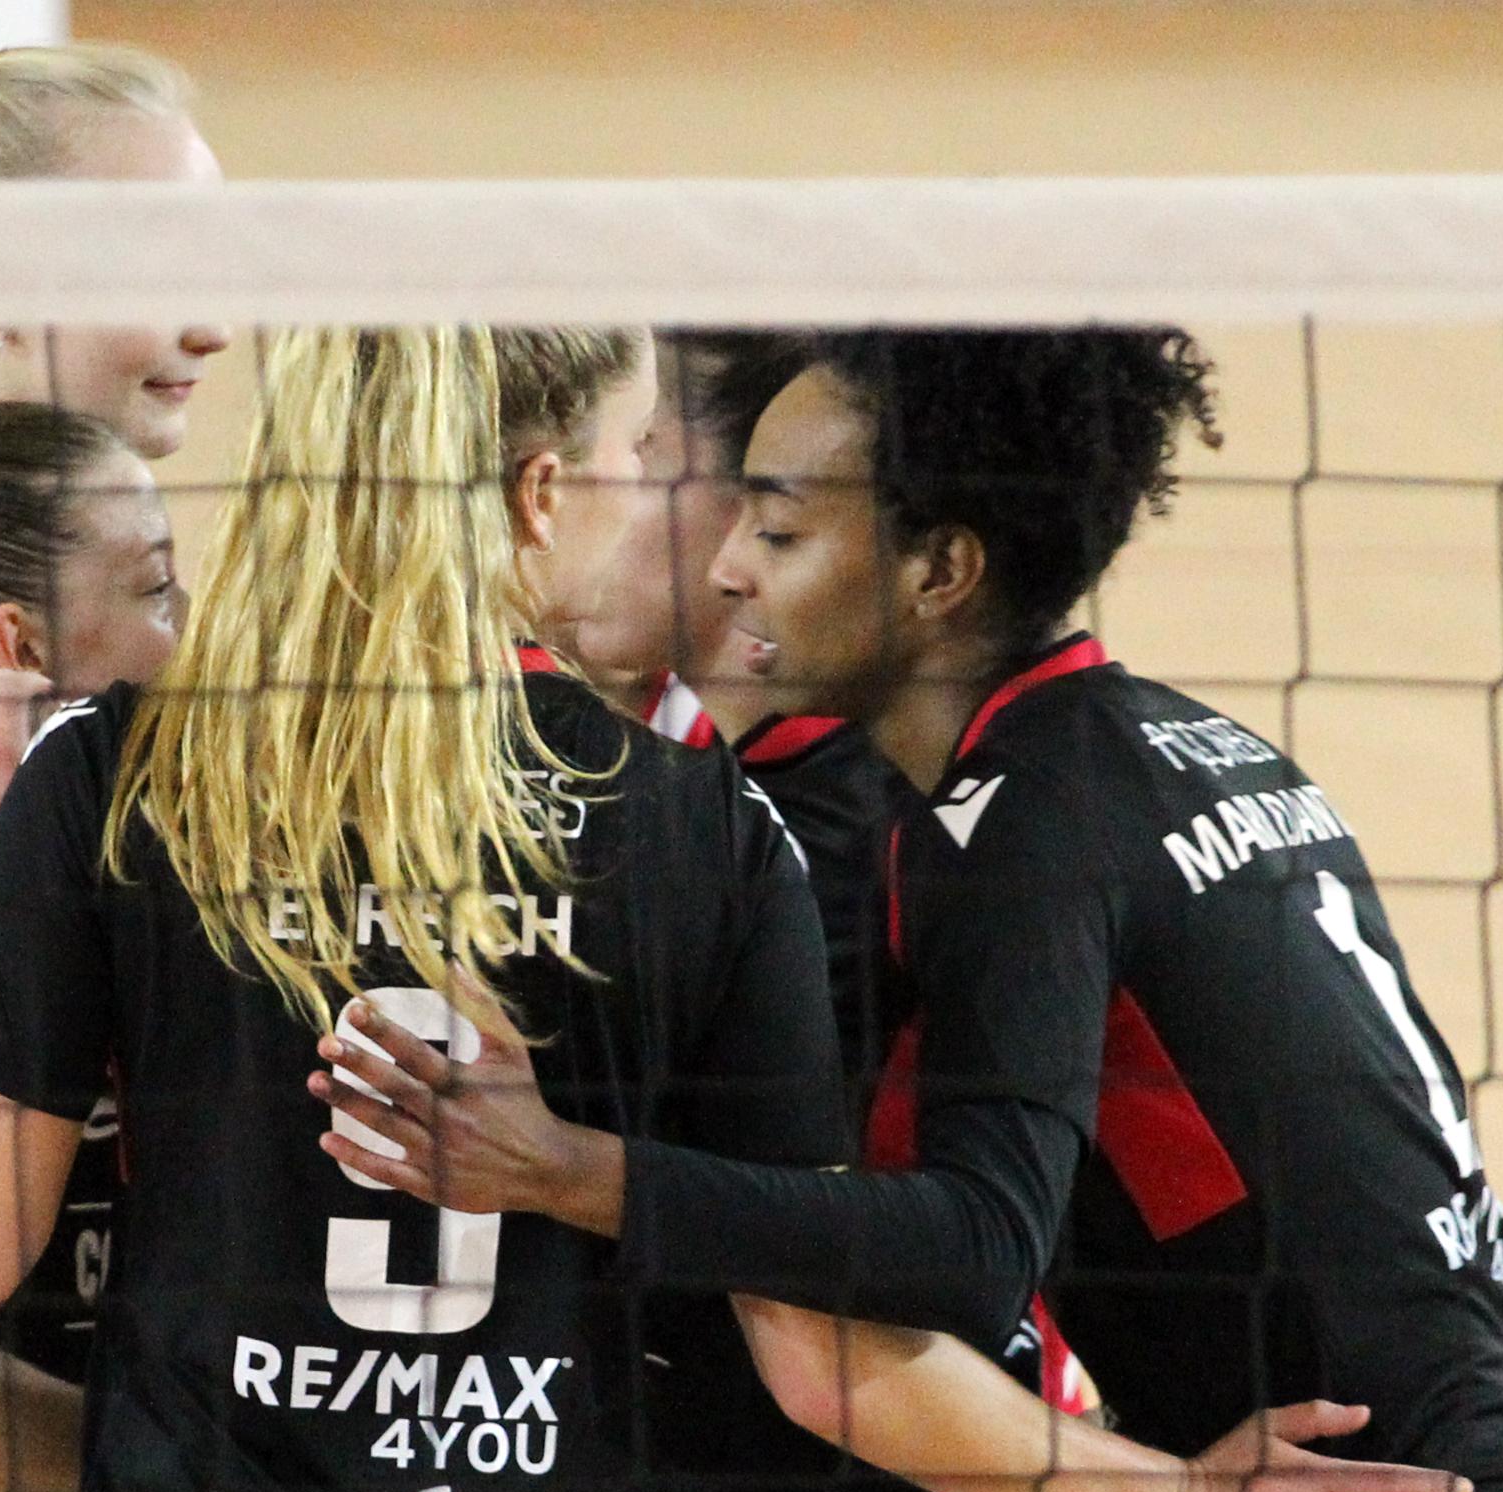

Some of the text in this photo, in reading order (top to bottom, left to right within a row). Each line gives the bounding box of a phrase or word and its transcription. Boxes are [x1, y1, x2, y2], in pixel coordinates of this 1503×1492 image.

[1313, 870, 1483, 1178] 1
[325, 987, 501, 1333] 9
[233, 1336, 560, 1421] RE/MAX
[370, 1418, 559, 1475] 4YOU
